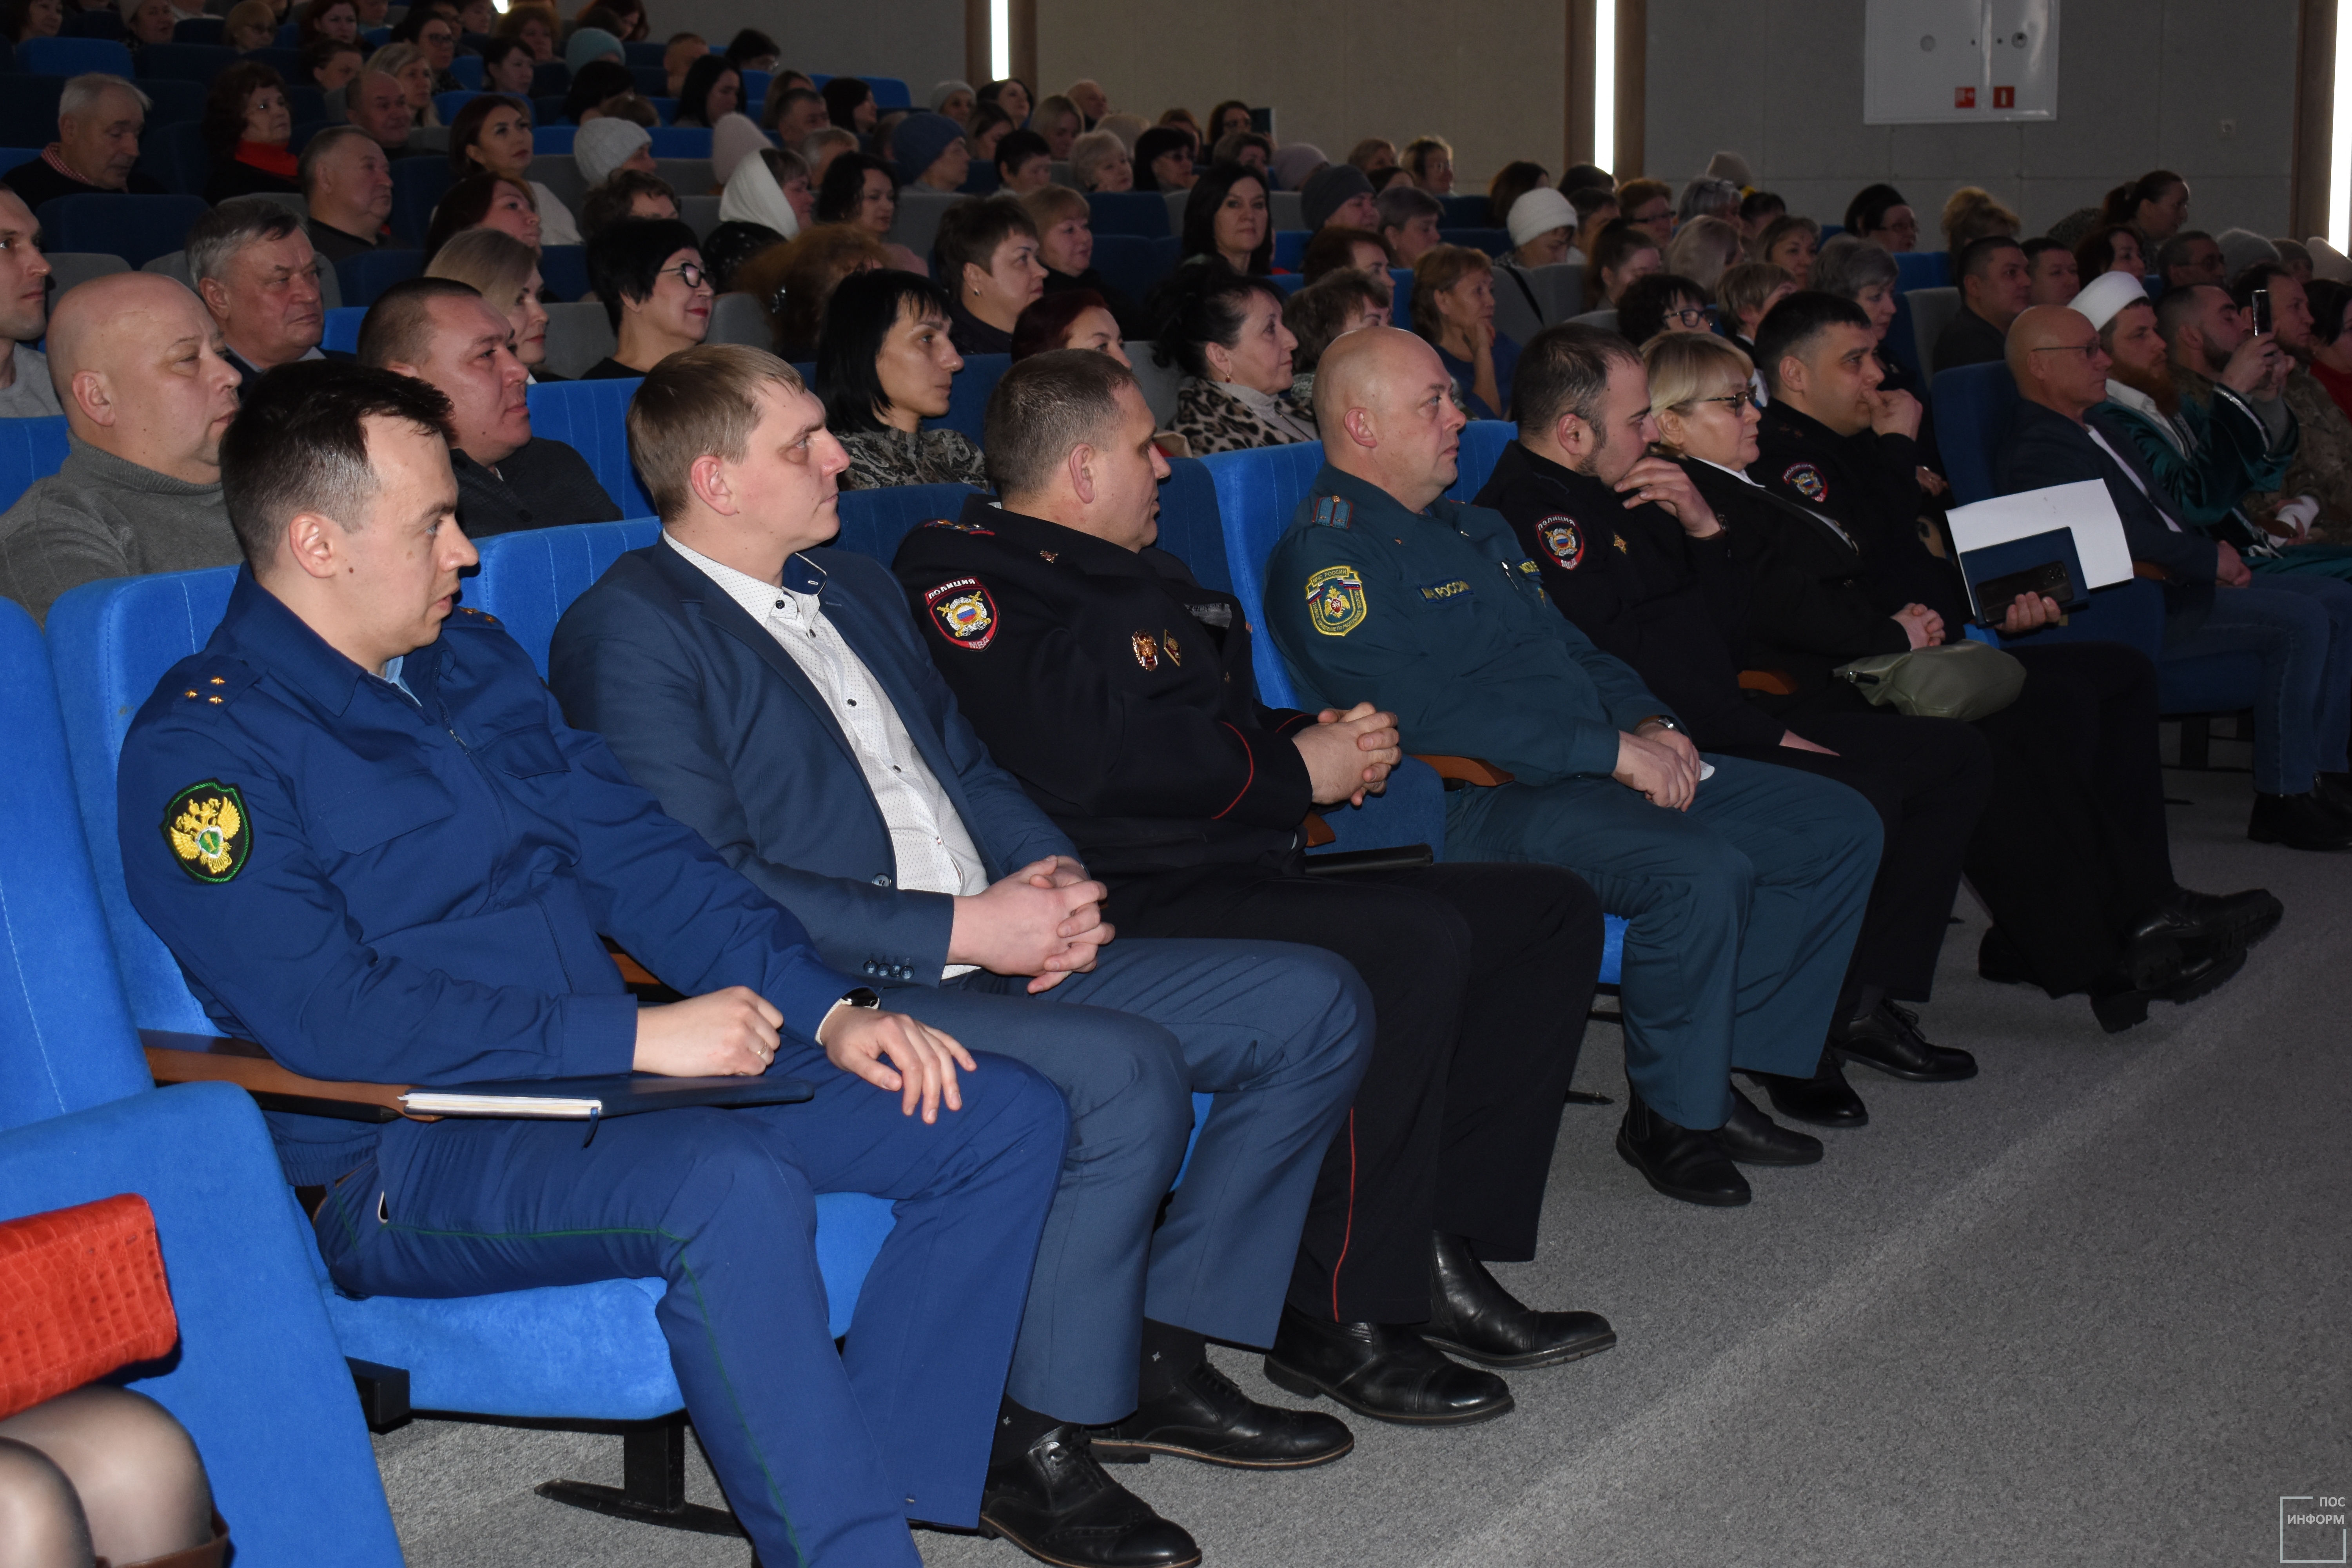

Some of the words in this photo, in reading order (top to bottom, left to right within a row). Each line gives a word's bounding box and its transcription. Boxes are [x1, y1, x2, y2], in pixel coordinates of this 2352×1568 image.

[1784, 464, 1815, 481] ПОЛИЦИЯ
[1537, 515, 1576, 531] ПОЛИЦИЯ
[1312, 575, 1323, 584] МЧС
[928, 579, 976, 599] ПОЛИЦИЯ
[1317, 619, 1337, 632] УПРАВЛЕНИЕ
[1343, 610, 1362, 628] РЕСПУБЛИКЕ
[968, 635, 990, 649] МВД
